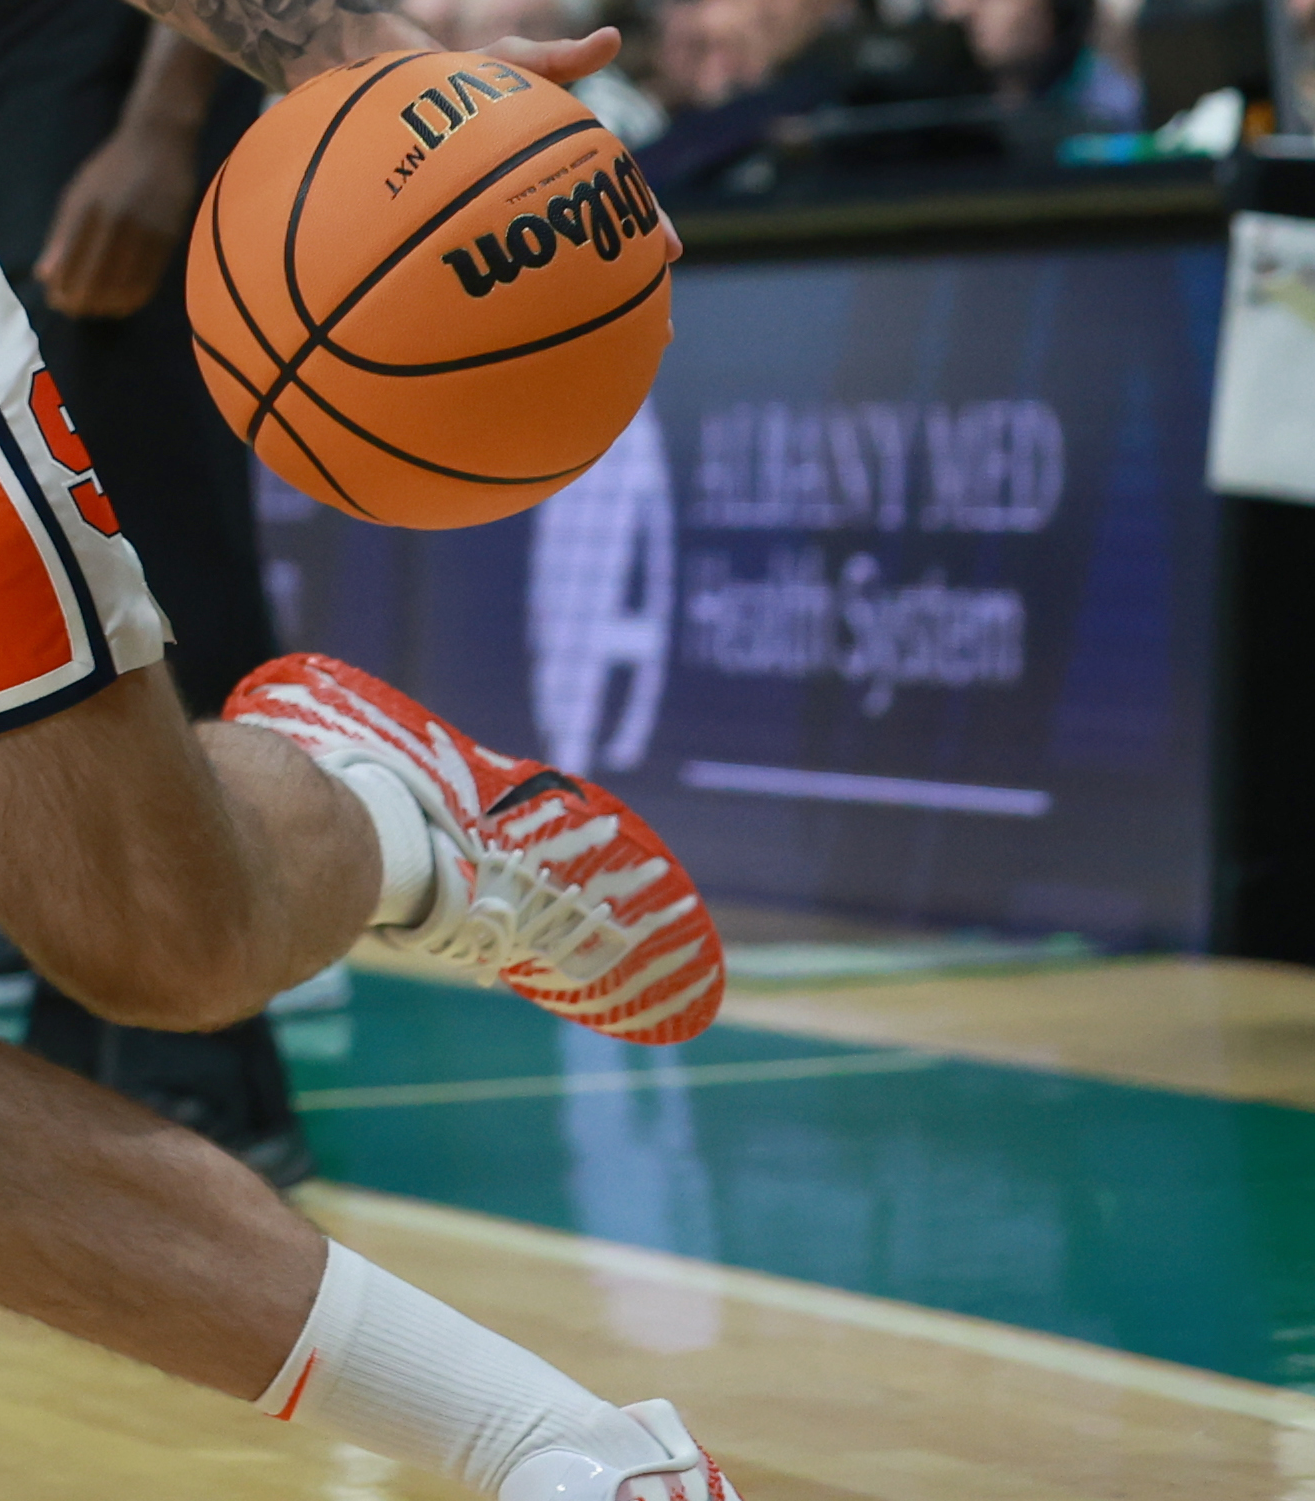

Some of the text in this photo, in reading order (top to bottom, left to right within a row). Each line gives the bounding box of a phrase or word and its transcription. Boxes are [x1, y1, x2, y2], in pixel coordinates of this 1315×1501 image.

[383, 61, 532, 200] EVO NXT
[440, 150, 659, 298] Wilson
[689, 398, 1065, 533] ALBANY MED
[679, 548, 1027, 716] Health System
